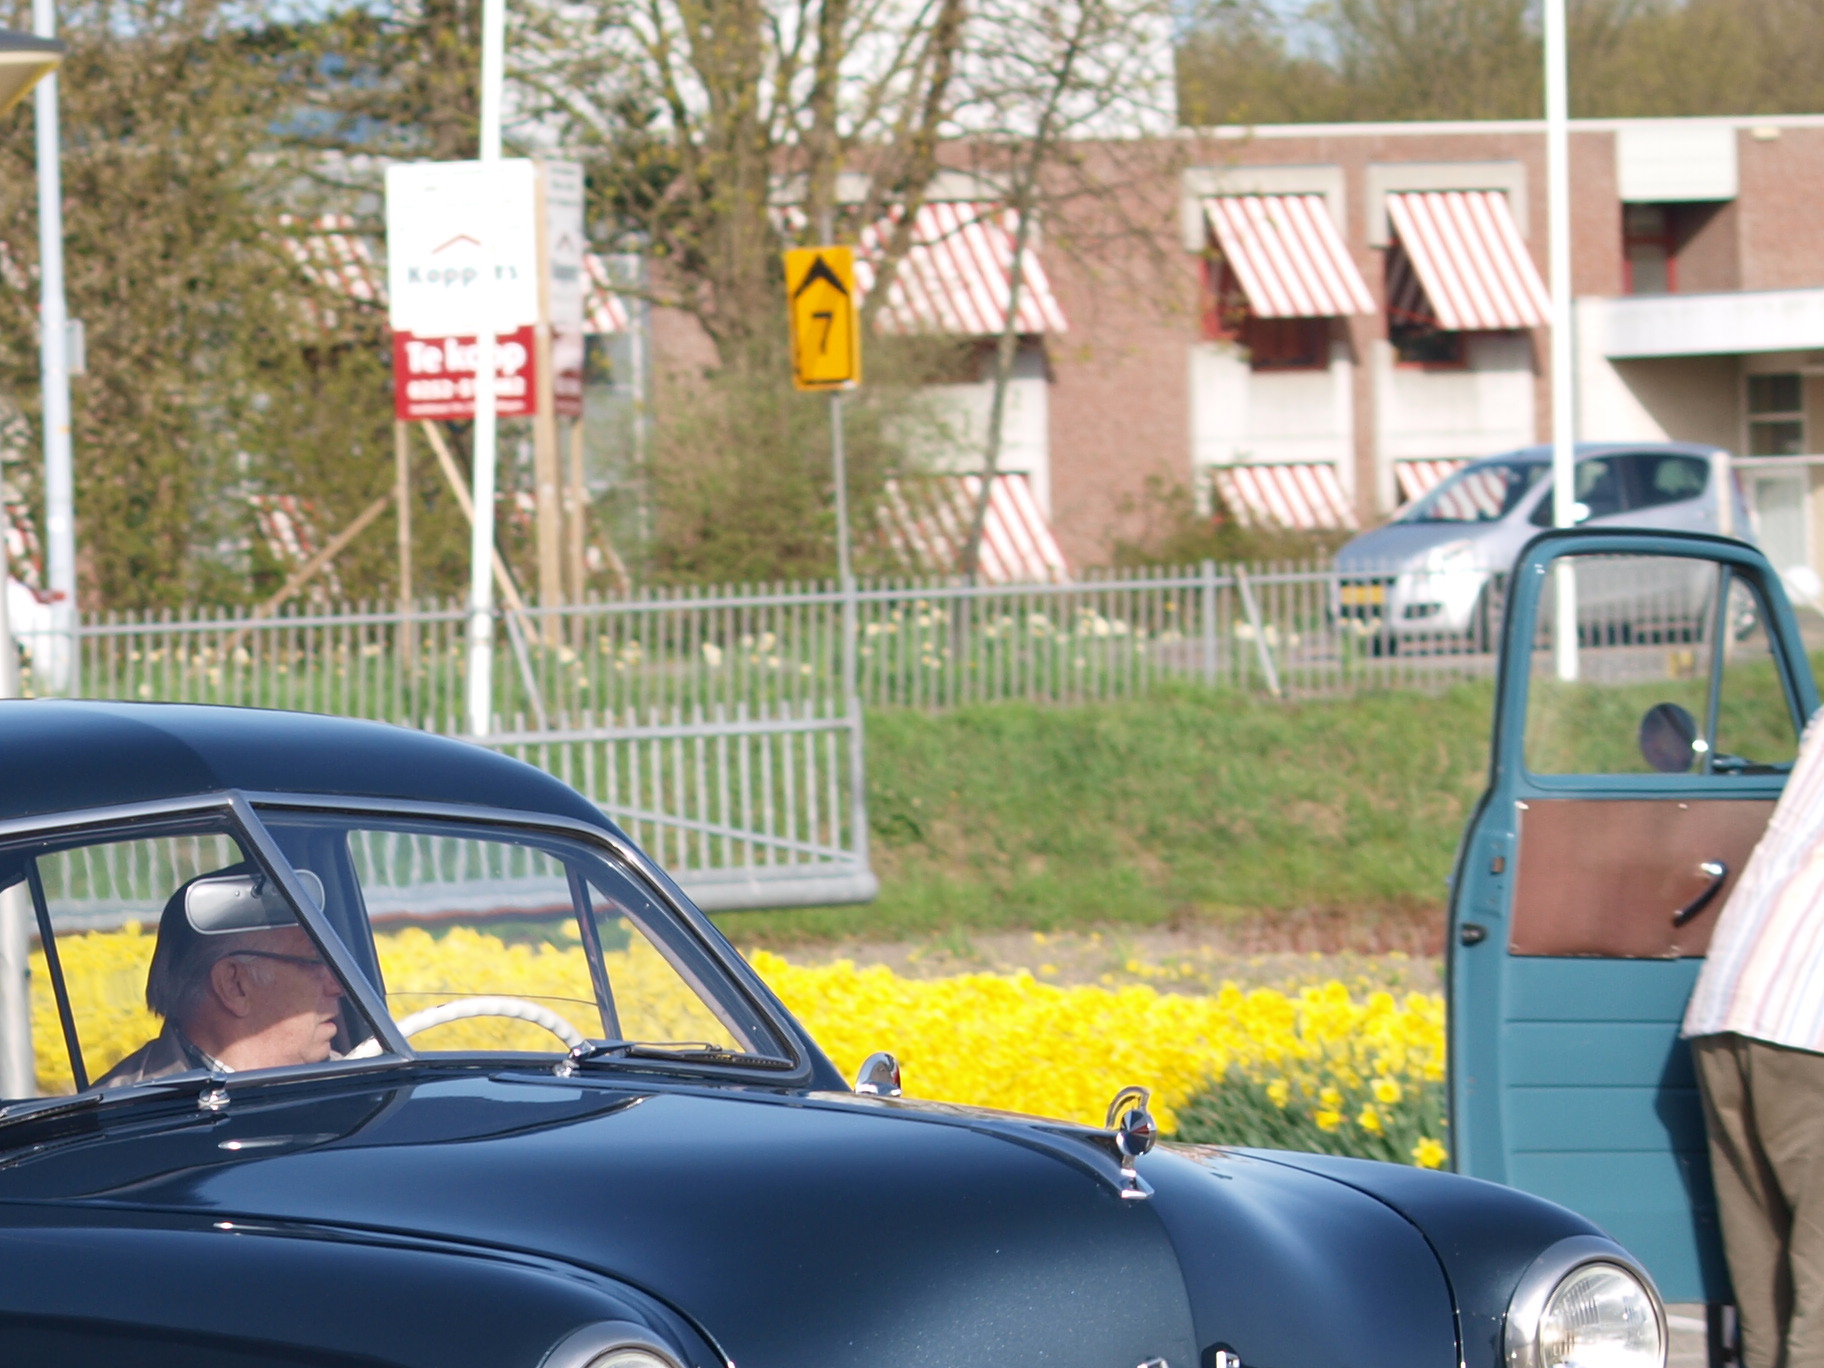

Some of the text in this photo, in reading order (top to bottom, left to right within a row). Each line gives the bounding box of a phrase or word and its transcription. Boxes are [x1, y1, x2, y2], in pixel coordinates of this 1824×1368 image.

[812, 311, 833, 355] 7
[405, 341, 442, 373] Te
[445, 337, 527, 376] kop
